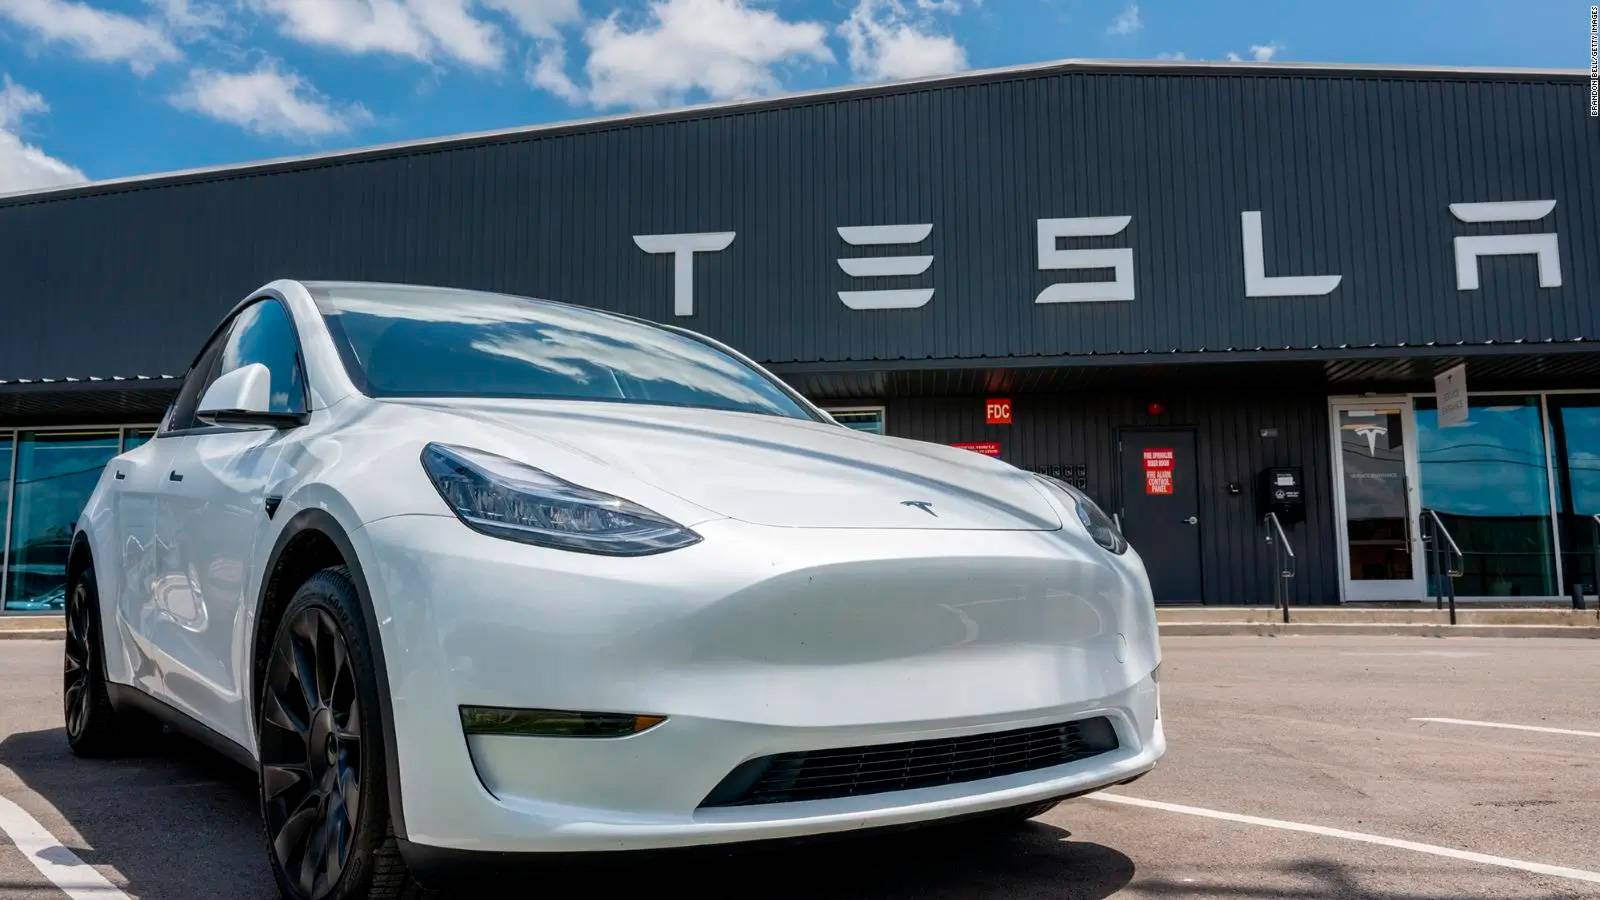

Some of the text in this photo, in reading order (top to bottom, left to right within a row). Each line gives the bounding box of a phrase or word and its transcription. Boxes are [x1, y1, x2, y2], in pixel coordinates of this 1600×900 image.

[632, 199, 1562, 316] TESLA
[987, 404, 1010, 419] FDC
[1148, 478, 1170, 486] CONTROL
[1151, 485, 1168, 493] PANEL
